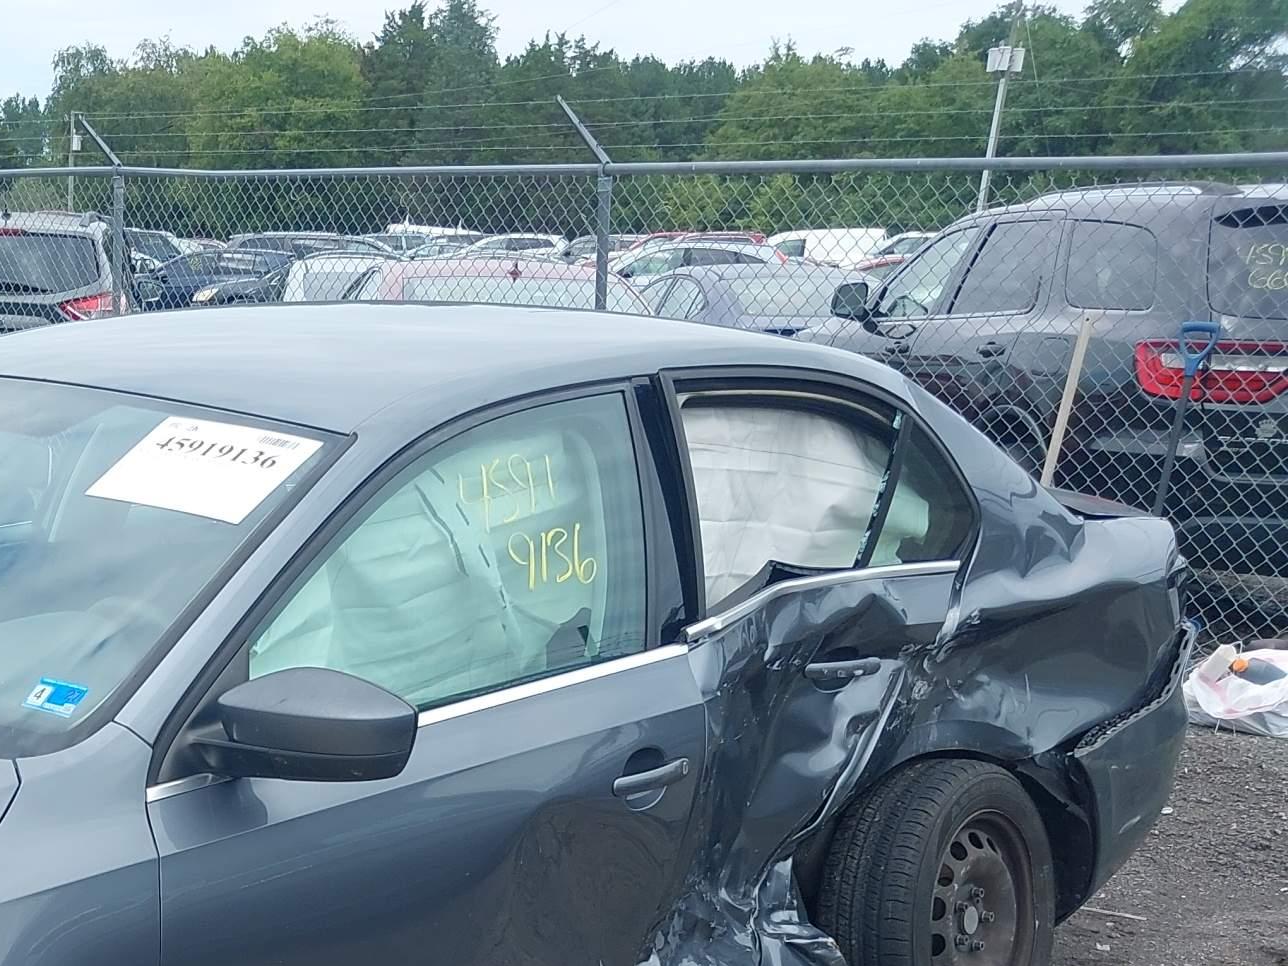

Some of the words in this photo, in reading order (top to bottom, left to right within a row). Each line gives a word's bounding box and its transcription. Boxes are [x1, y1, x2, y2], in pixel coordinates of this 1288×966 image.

[156, 436, 280, 469] 45919136
[458, 453, 556, 533] 4591
[507, 522, 597, 591] 9136
[34, 688, 47, 700] 4
